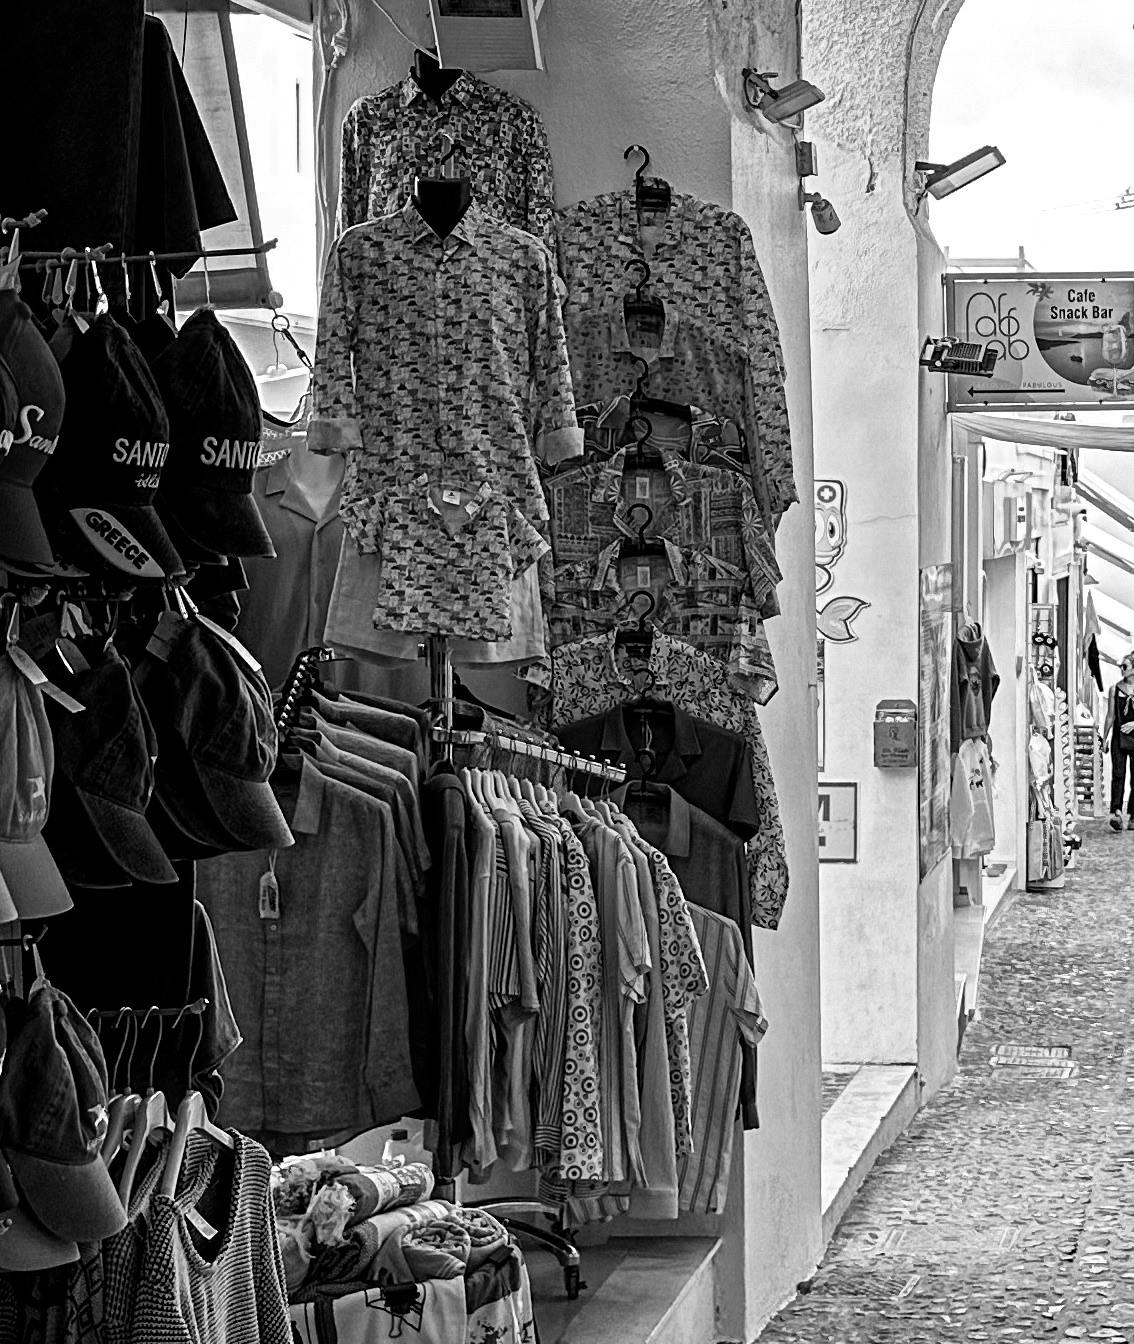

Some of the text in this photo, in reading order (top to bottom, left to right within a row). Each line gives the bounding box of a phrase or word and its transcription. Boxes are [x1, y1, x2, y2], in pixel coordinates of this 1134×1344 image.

[1067, 288, 1096, 303] Cafe
[1050, 306, 1113, 320] Snack Bar
[85, 511, 150, 570] GREECE
